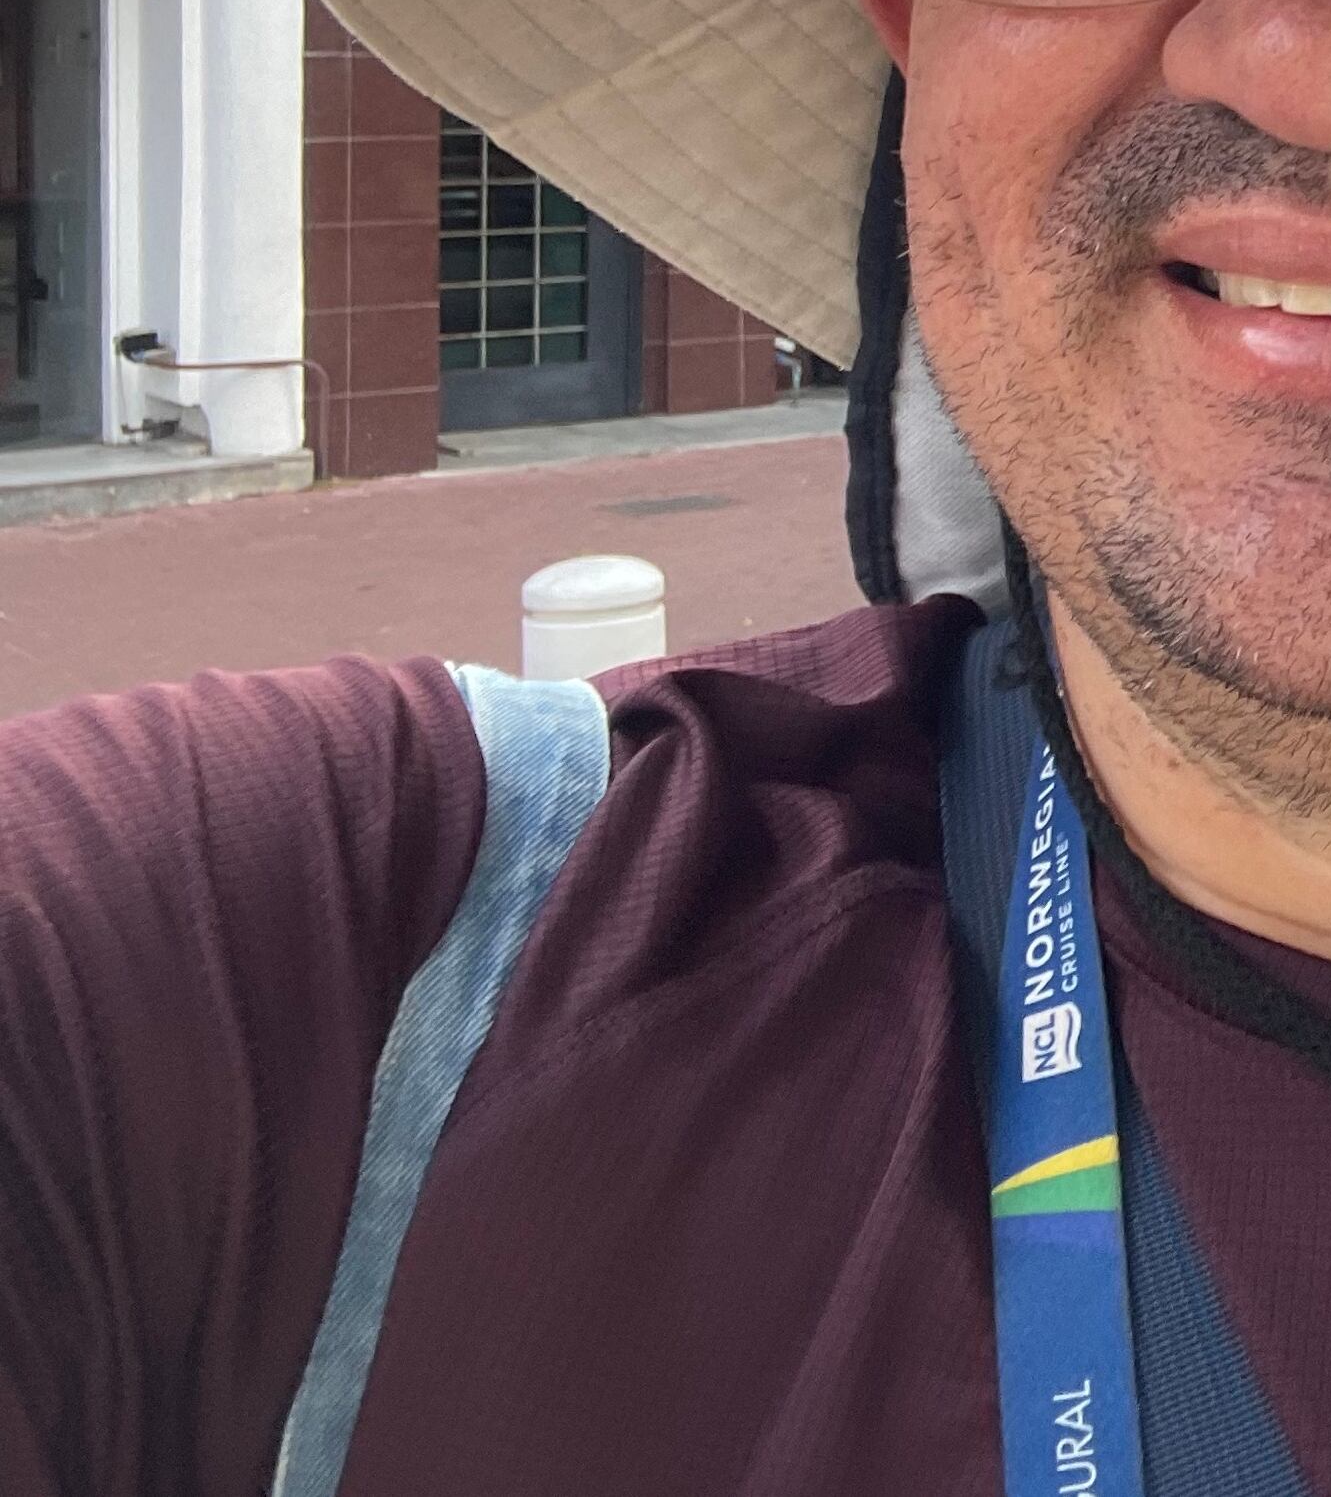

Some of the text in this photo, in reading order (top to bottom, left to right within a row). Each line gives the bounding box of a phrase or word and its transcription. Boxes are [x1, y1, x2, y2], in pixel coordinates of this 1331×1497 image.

[1024, 744, 1058, 1005] NORWEGIA
[1058, 899, 1079, 993] CRUISE
[1034, 1012, 1056, 1074] NCL
[1053, 1379, 1097, 1497] URAL
